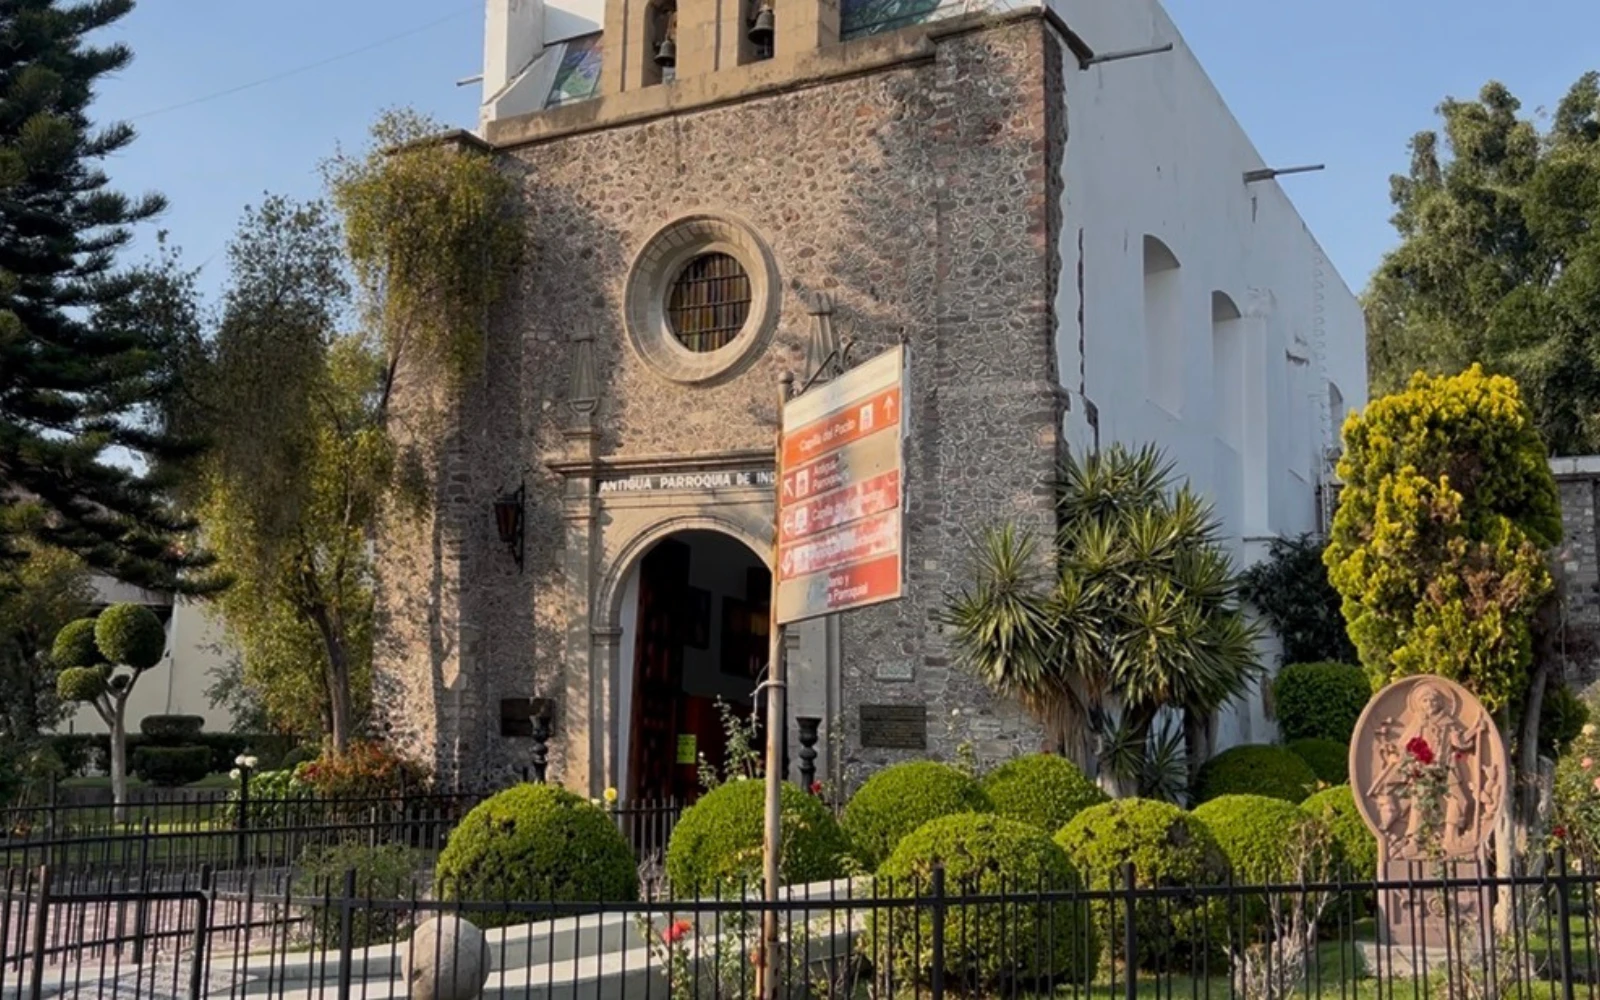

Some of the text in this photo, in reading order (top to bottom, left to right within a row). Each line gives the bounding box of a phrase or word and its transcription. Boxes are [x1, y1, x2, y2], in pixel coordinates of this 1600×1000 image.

[600, 478, 652, 492] ANTIGUA
[660, 472, 731, 489] PARROQUIA
[736, 471, 750, 485] DE
